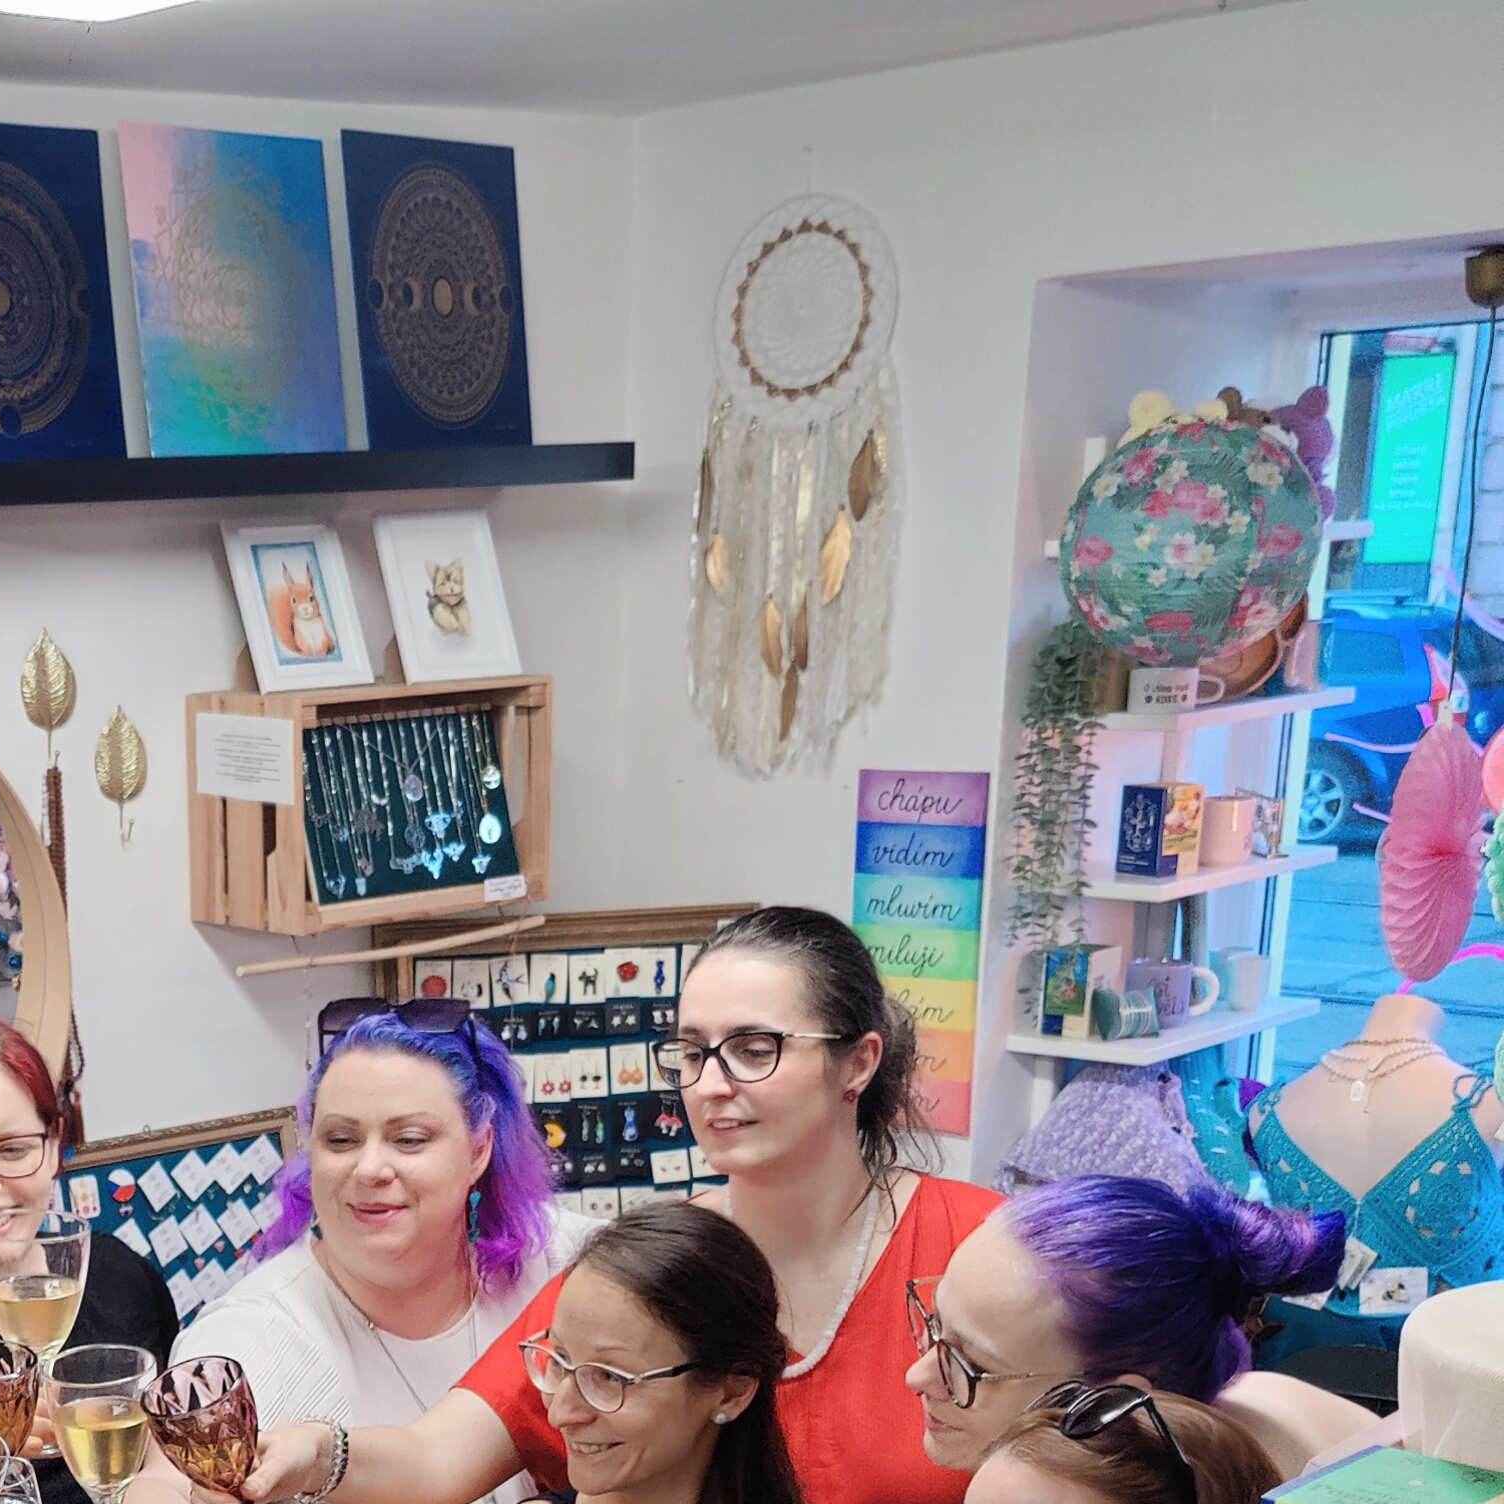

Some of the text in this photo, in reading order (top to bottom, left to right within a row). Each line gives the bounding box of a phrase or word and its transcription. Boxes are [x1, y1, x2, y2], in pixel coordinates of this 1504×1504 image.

[878, 778, 963, 823] chápu
[872, 831, 955, 868] vidím
[866, 884, 962, 921] mluvím
